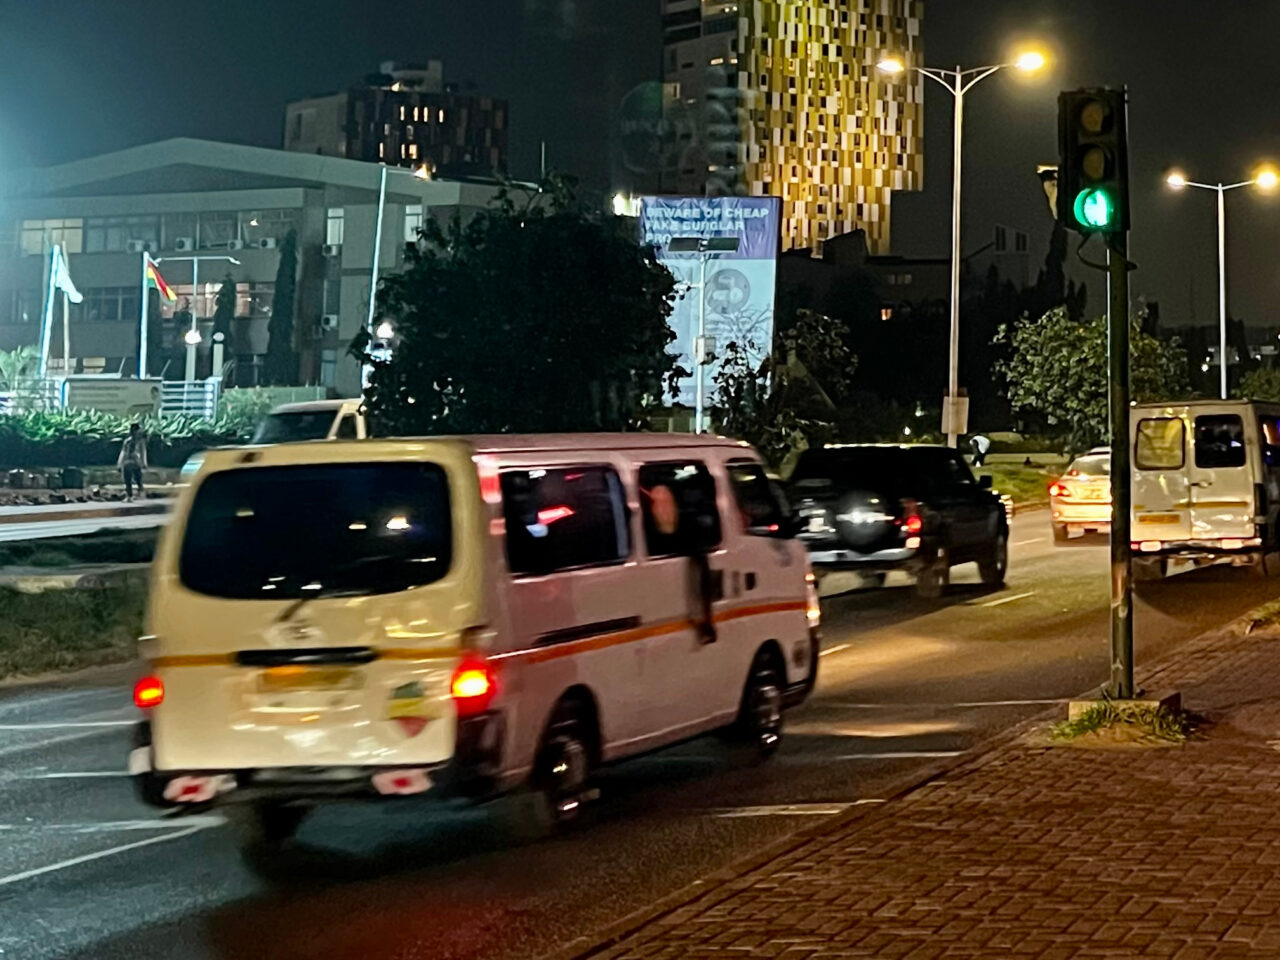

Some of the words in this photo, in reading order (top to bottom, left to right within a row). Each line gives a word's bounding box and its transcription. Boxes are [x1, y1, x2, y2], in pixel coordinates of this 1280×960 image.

[646, 207, 700, 218] BEWARE
[704, 207, 722, 218] OF
[726, 207, 769, 218] CHEAP
